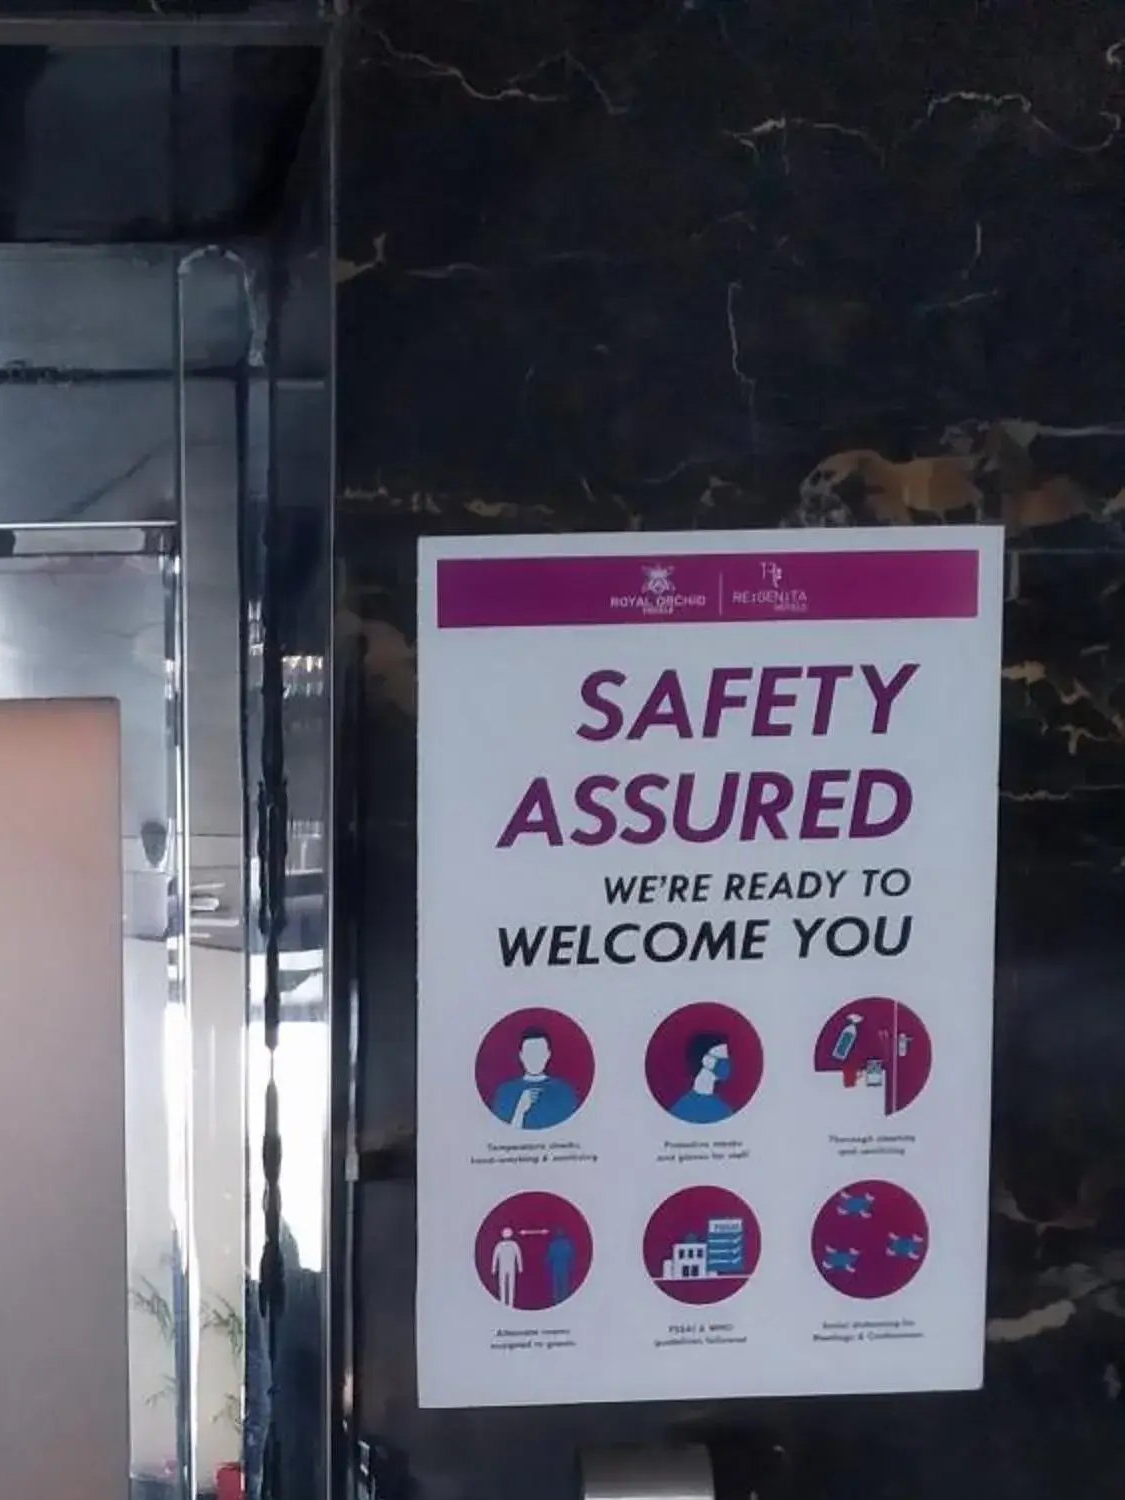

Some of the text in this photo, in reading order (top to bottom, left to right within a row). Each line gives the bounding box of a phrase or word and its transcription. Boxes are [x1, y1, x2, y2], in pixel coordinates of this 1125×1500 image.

[575, 663, 921, 742] SAFETY
[494, 767, 914, 848] ASSURED
[603, 866, 912, 905] WE'RE READY TO
[496, 914, 914, 968] WELCOME YOU
